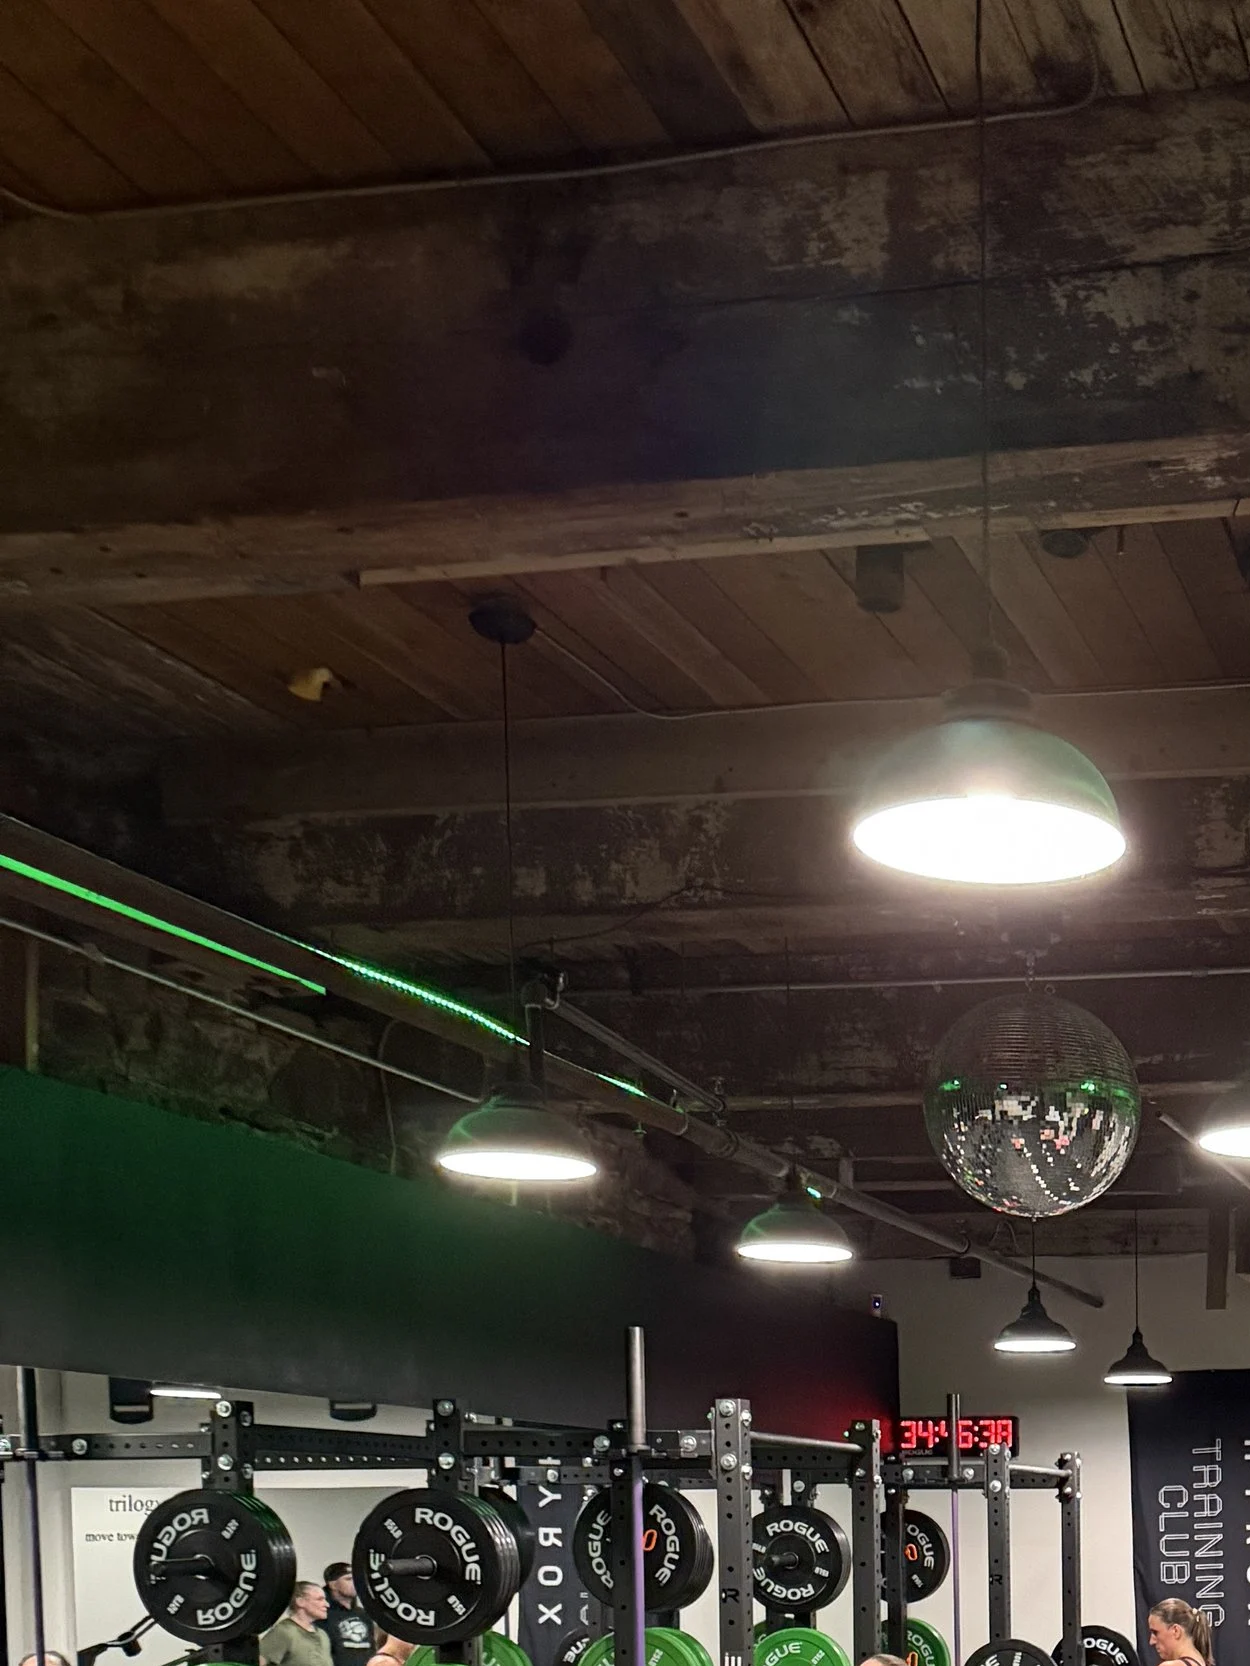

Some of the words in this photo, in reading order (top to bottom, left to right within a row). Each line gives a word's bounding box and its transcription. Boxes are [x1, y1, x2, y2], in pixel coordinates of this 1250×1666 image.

[85, 1533, 114, 1542] move
[117, 1532, 137, 1541] tow
[384, 1518, 403, 1539] 15LB
[415, 1508, 482, 1585] ROGUE
[588, 1510, 614, 1590] ROGUE
[649, 1504, 681, 1587] ROGUE
[766, 1519, 830, 1554] ROGUE
[904, 1523, 935, 1570] OGUE
[1158, 1485, 1190, 1584] CLUB
[1192, 1438, 1225, 1627] TRAINING
[369, 1549, 435, 1627] ROGUE
[447, 1595, 466, 1616] 15LB
[753, 1566, 815, 1600] ROGUE
[1083, 1637, 1129, 1666] OGUE
